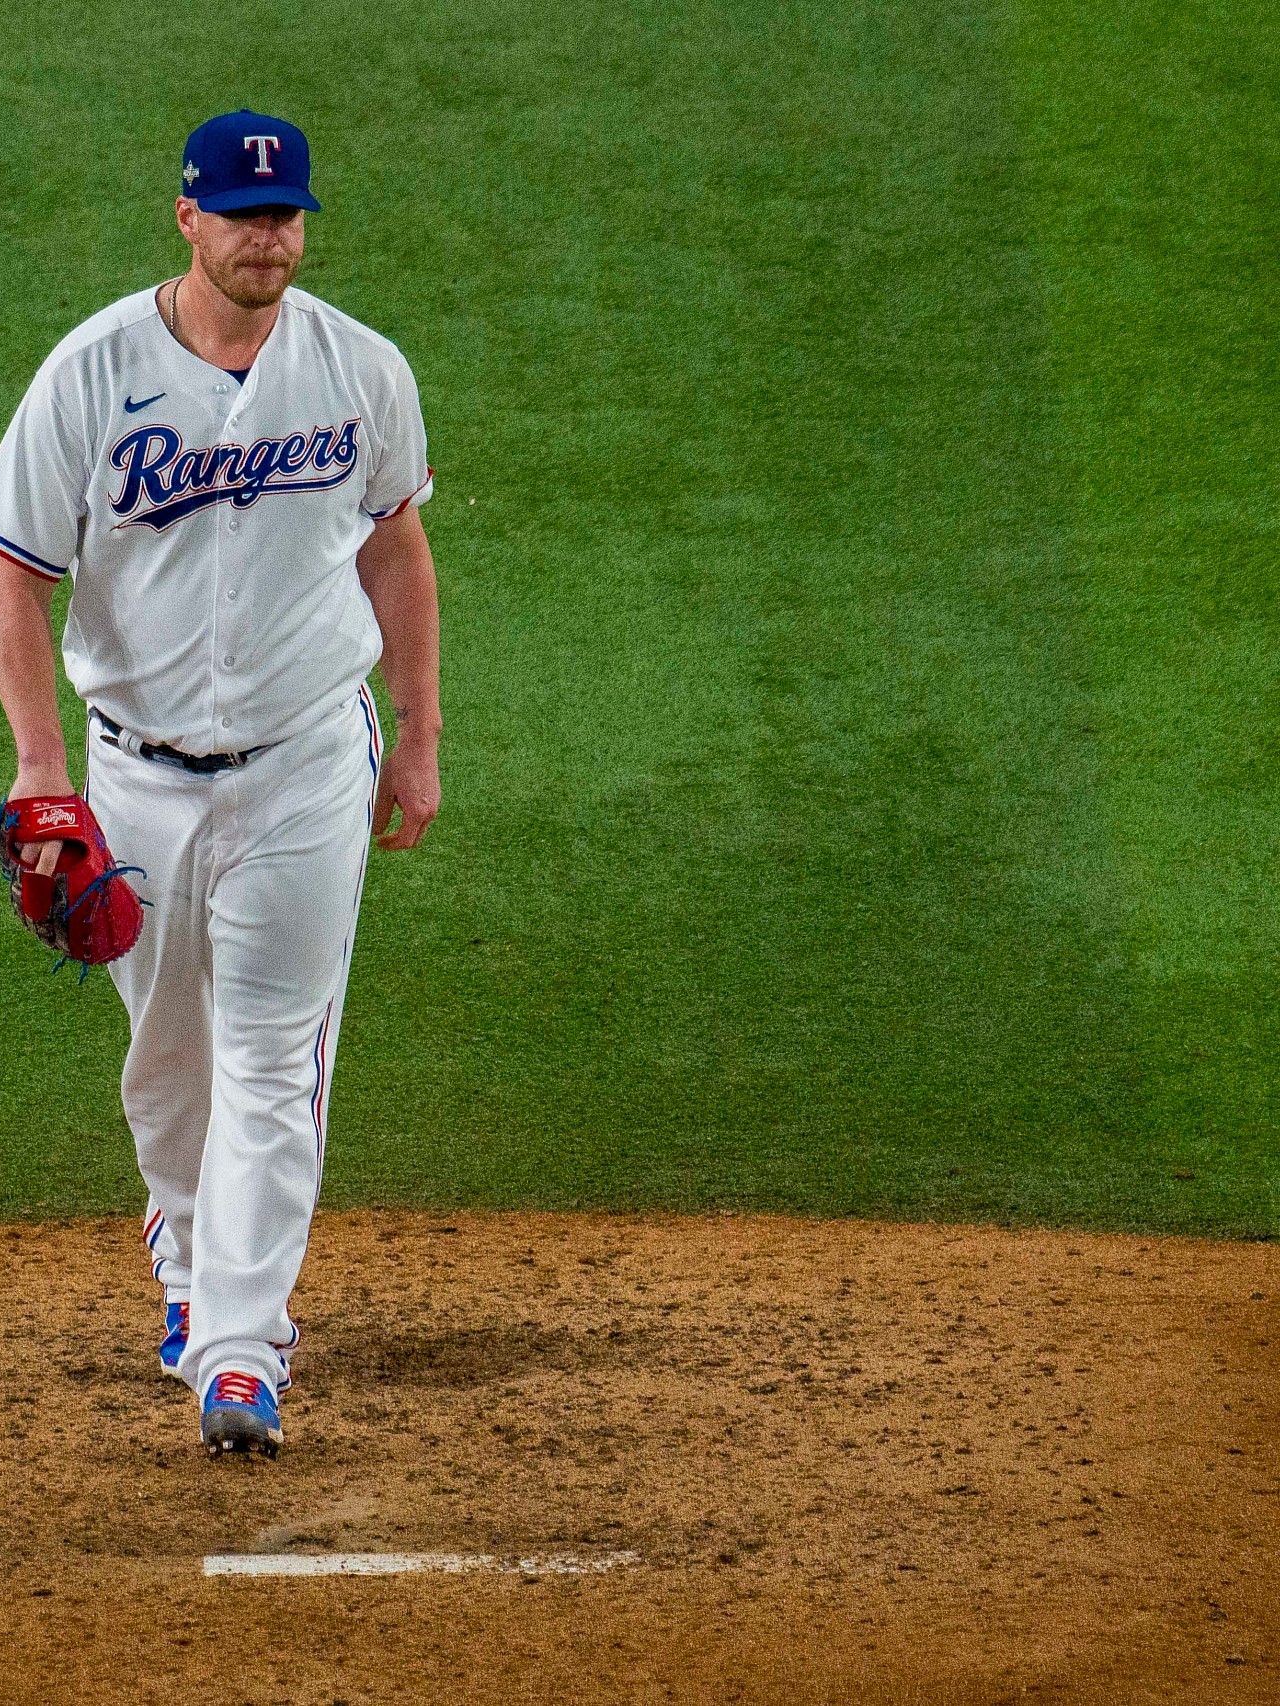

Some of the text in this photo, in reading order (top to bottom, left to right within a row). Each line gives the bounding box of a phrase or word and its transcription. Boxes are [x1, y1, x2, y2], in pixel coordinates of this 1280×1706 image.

[243, 135, 281, 177] T
[108, 417, 361, 532] Rangers
[37, 811, 76, 826] Rawlings
